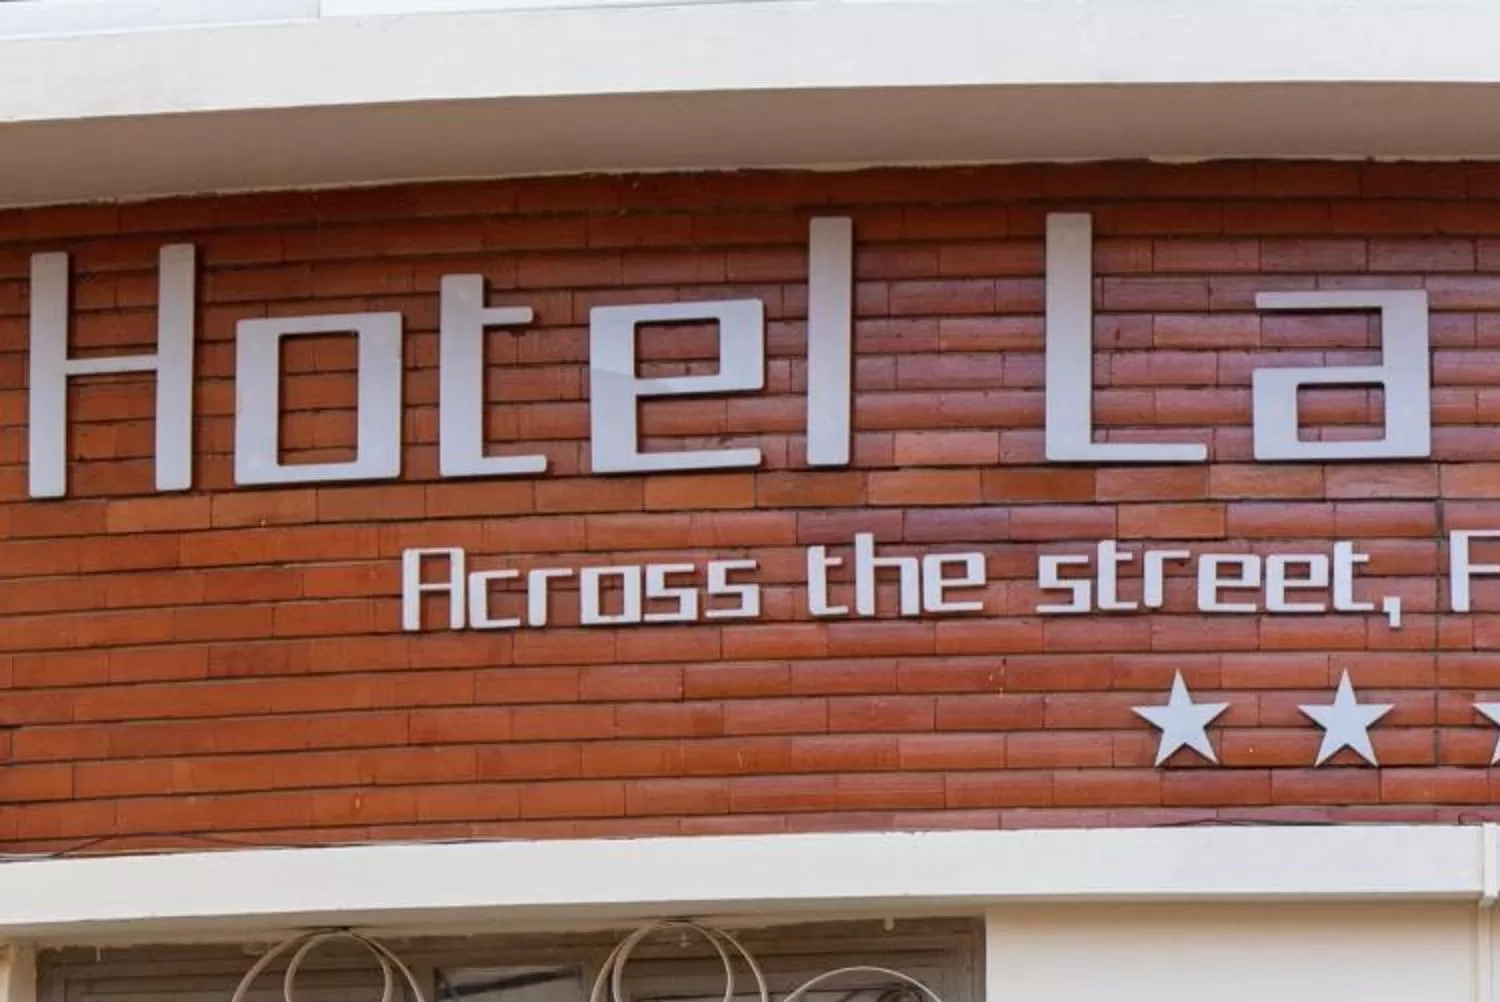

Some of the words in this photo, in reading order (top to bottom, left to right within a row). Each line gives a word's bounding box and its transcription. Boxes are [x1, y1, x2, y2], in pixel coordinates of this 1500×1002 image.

[28, 215, 853, 498] Hotel
[1045, 211, 1431, 461] La
[401, 546, 760, 631] Across
[806, 532, 987, 617] the
[1036, 538, 1401, 628] street,
